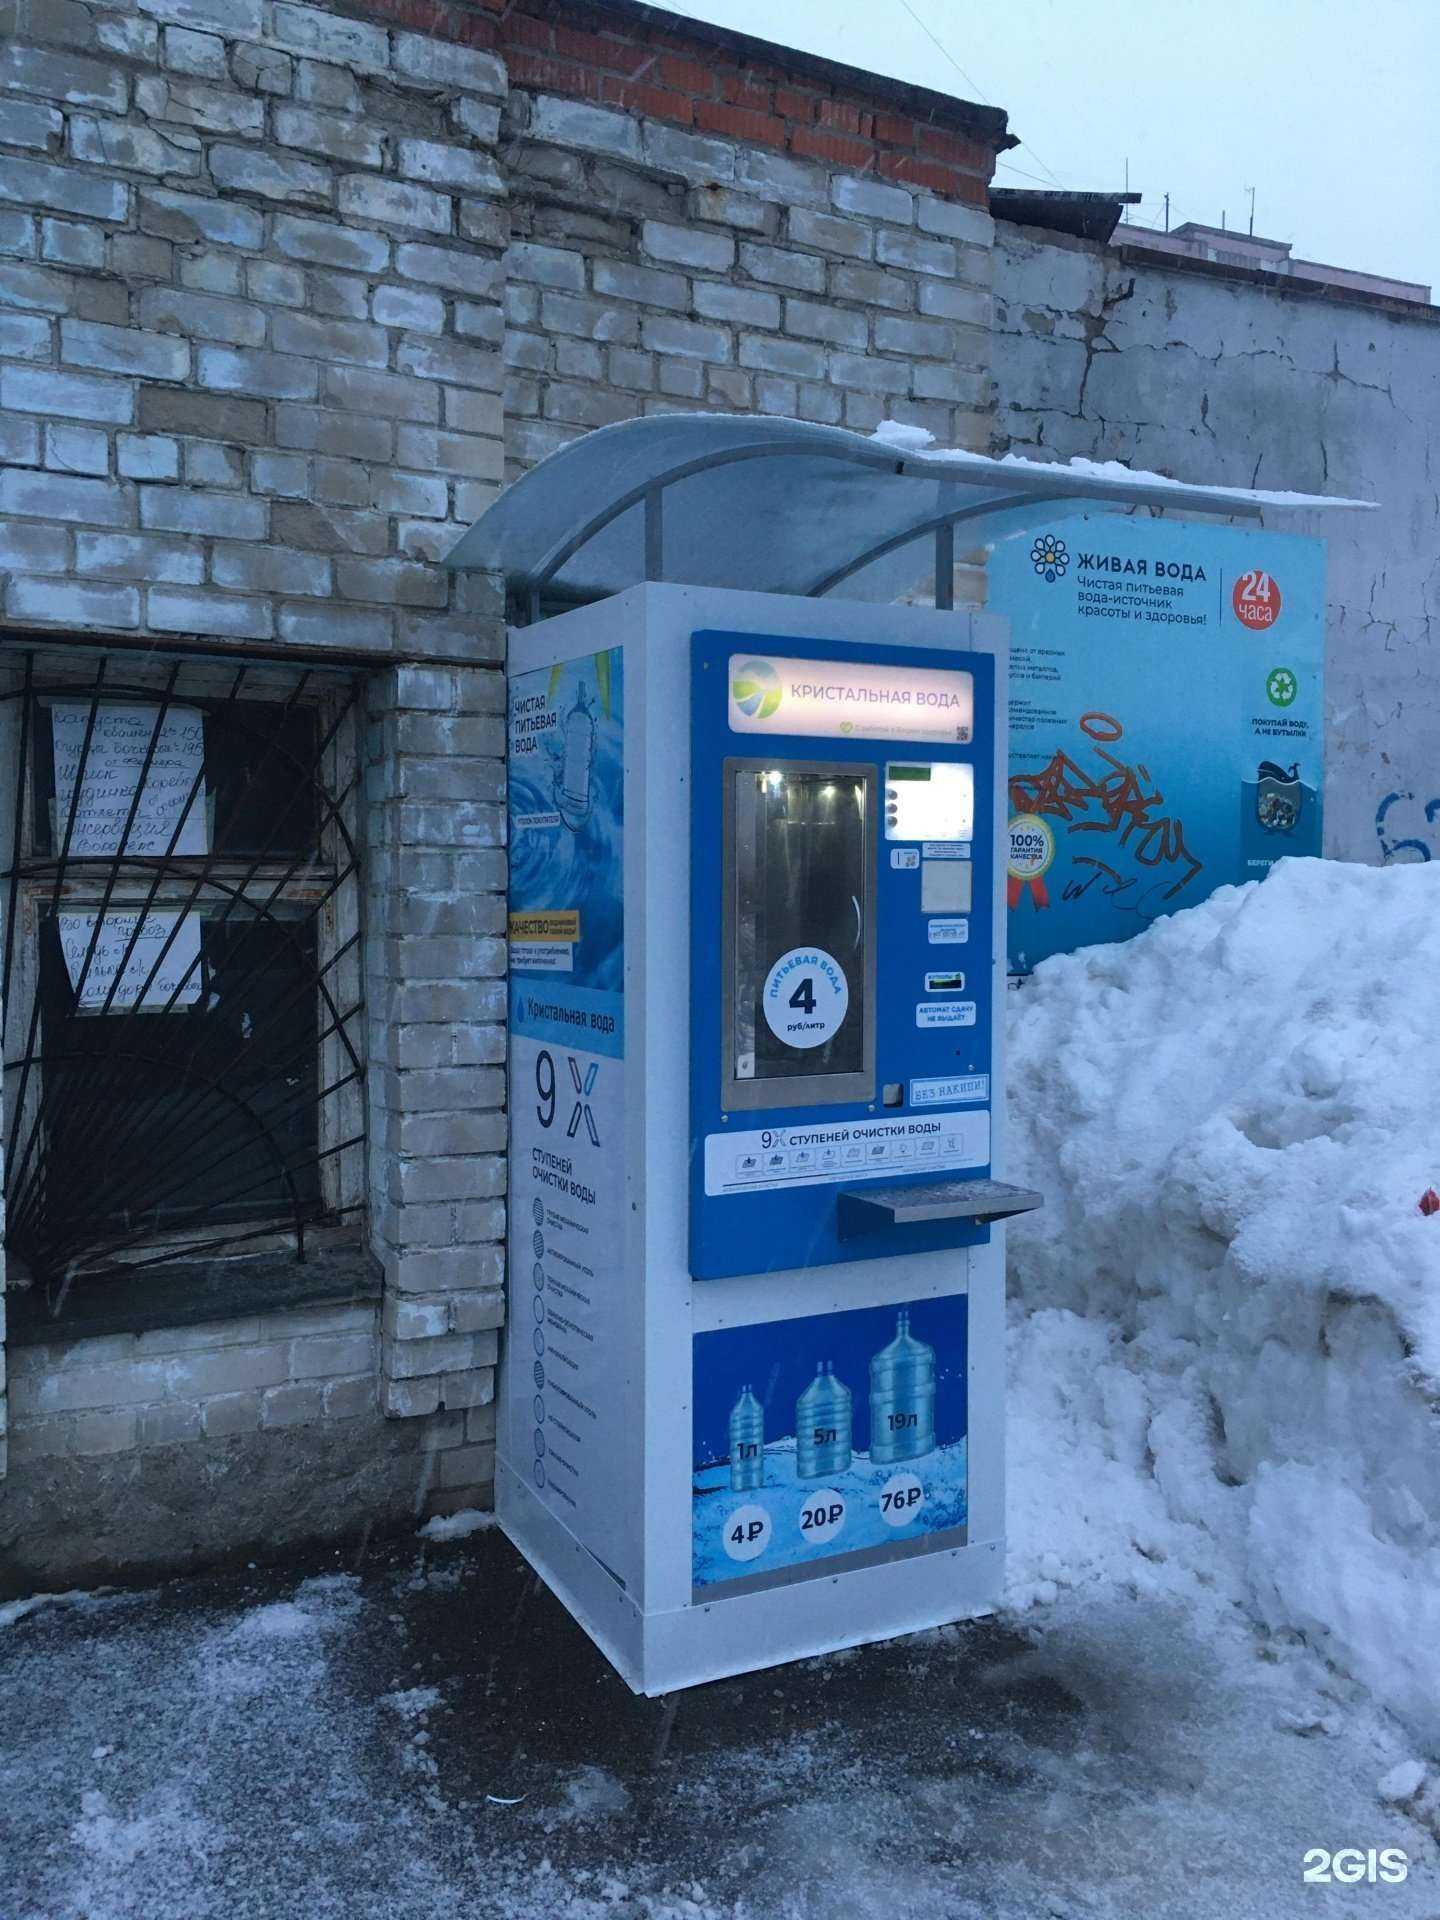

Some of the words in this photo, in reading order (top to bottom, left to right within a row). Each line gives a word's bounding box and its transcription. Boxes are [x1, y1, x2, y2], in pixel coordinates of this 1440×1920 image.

[1077, 552, 1148, 577] ЖИВАЯ
[1154, 562, 1207, 583] ВОДА
[1077, 576, 1123, 592] Чистая
[1126, 582, 1184, 598] питьевая
[1241, 570, 1271, 603] 24
[1077, 592, 1173, 609] вода-источник
[1077, 606, 1131, 621] красоты
[1134, 611, 1142, 621] и
[1145, 611, 1208, 626] здоровья!
[1239, 604, 1273, 623] часа
[514, 695, 546, 713] ЧИСТАЯ
[791, 684, 911, 706] КРИСТАЛЬНАЯ
[916, 692, 960, 709] ВОДА
[514, 711, 557, 734] ПИТЬЕВАЯ
[1252, 718, 1288, 728] ПОКУПАЙ
[1254, 728, 1261, 736] А
[1262, 728, 1271, 736] НЕ
[1272, 729, 1306, 738] БУТЫЛКИ
[515, 736, 538, 753] ВОДА
[1010, 834, 1044, 848] 100%
[770, 955, 818, 998] ПИТЬЕВАЯ
[820, 960, 842, 995] ВОДА
[788, 978, 817, 1014] 4
[527, 997, 588, 1027] Кристальная
[591, 1012, 615, 1035] вода
[919, 1006, 950, 1014] АВТОМАТ
[787, 1021, 825, 1032] руб/литр
[914, 1088, 936, 1101] БЕЗ
[938, 1079, 985, 1097] НАКИПИ!
[789, 1126, 849, 1146] СТУПЕНЕЙ
[852, 1124, 905, 1140] ОЧИСТКИ
[908, 1121, 941, 1135] ВОДЫ
[532, 1147, 573, 1177] СТУПЕНЕЙ
[532, 1166, 569, 1194] ОЧИСТКИ
[570, 1182, 596, 1206] ВОДЫ
[887, 1412, 918, 1432] 19л
[813, 1427, 837, 1445] 5л
[736, 1442, 758, 1460] 1л
